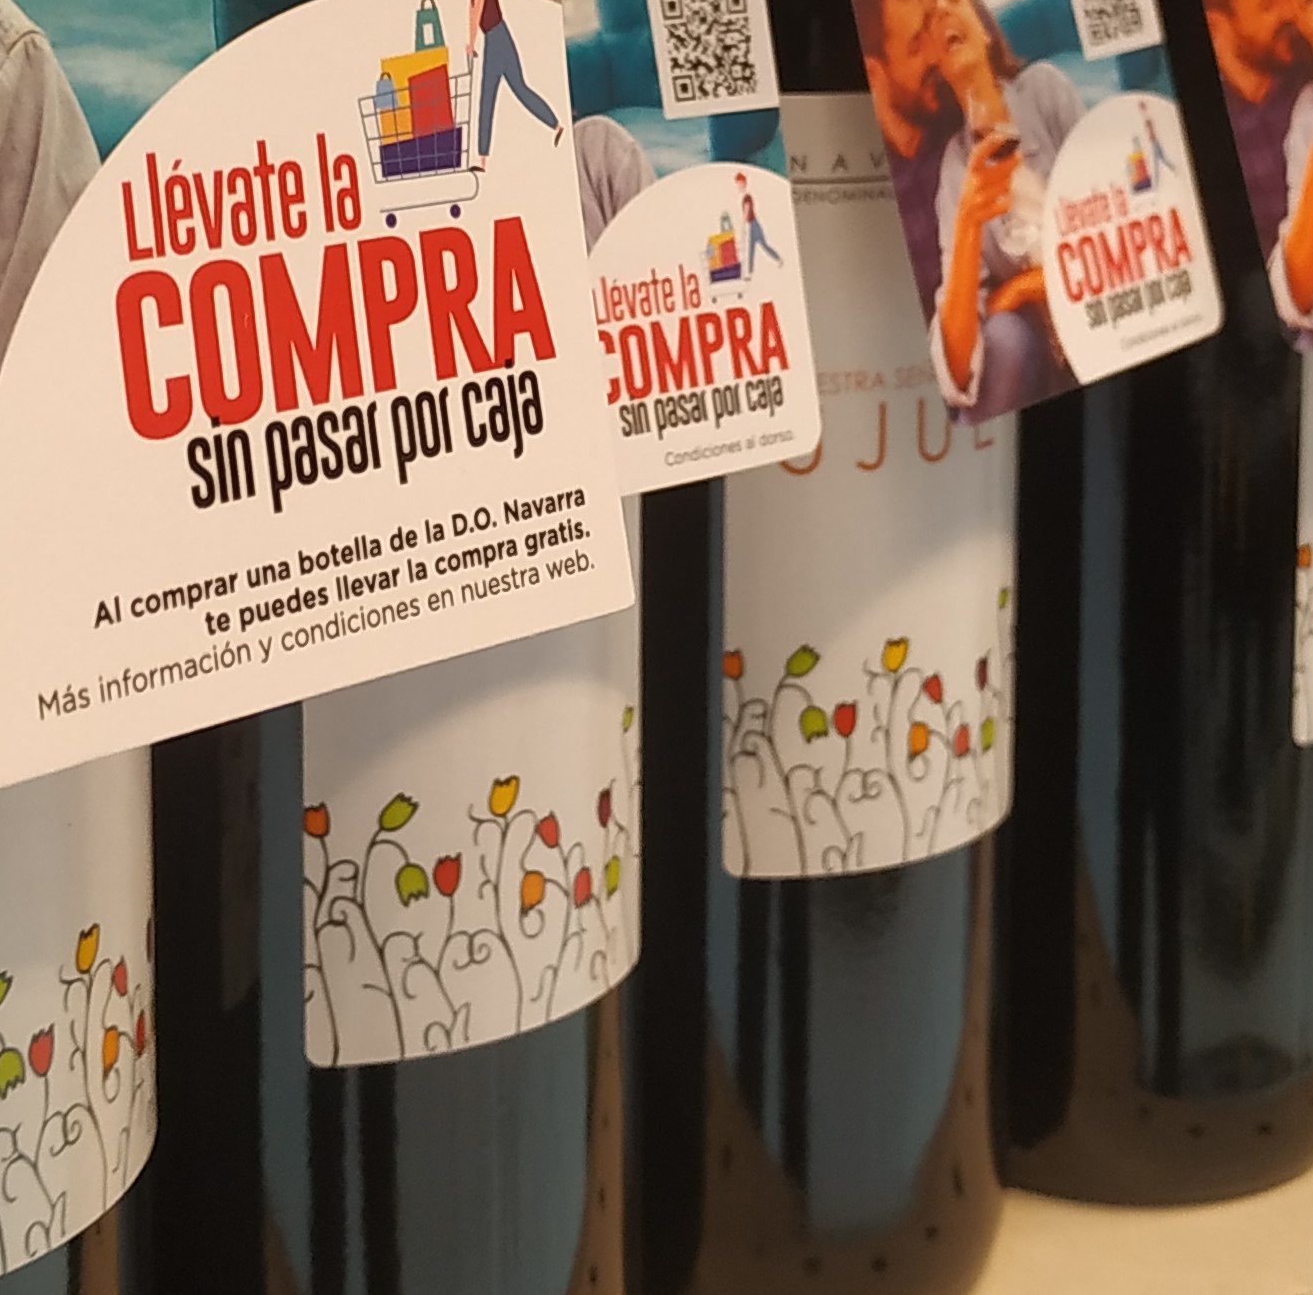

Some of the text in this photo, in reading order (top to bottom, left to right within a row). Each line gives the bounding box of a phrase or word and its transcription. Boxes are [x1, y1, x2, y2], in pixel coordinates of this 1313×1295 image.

[121, 133, 363, 261] Llévate la
[1057, 206, 1193, 303] COMPRA
[115, 216, 557, 441] COMPRA
[679, 264, 701, 311] la
[187, 358, 544, 513] sin pasar por caja
[619, 374, 785, 441] sin pasar por caja
[664, 441, 741, 467] Condiciones
[93, 488, 586, 629] Al comprar una botella de la D.O. Navarra
[204, 520, 591, 636] te puedes llevar la compra gratis.
[37, 549, 595, 721] Más información y condiciones en nuestra web.
